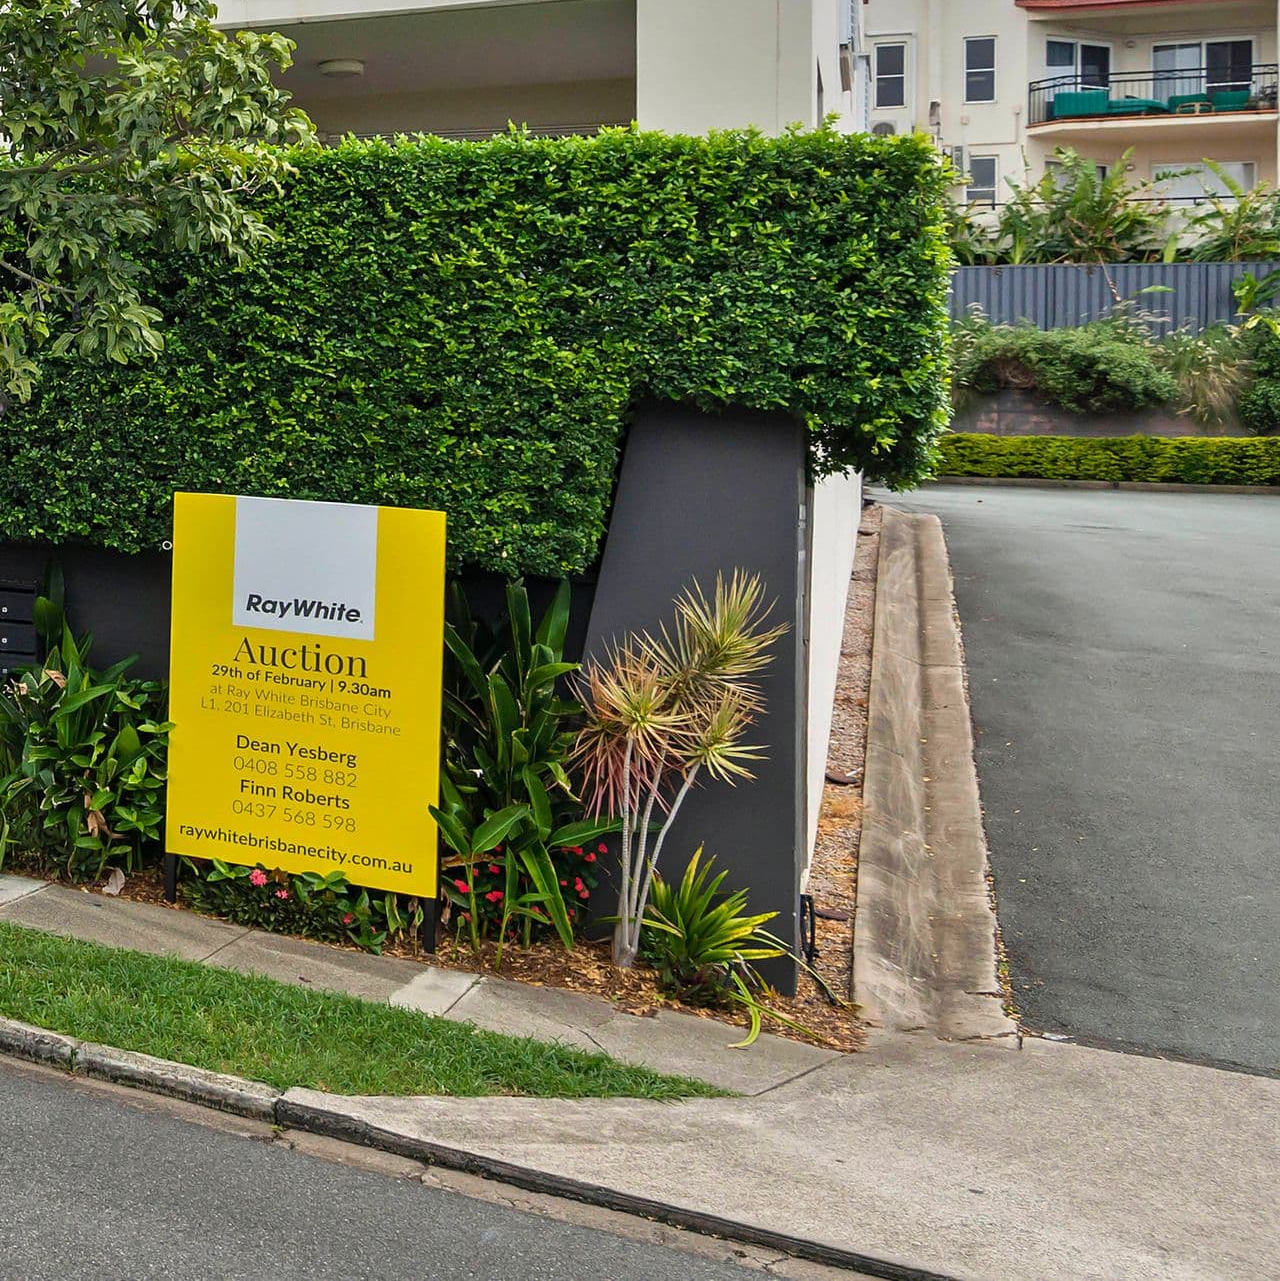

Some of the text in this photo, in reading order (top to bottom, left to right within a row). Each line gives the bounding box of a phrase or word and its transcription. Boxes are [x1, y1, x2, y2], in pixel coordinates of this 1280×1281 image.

[233, 637, 368, 678] Auction
[211, 664, 243, 680] 29th
[246, 670, 261, 681] of
[265, 671, 326, 692] February
[338, 680, 392, 699] 9.30am
[210, 685, 392, 719] at Ray White Brisbane City
[224, 700, 249, 715] 201
[254, 704, 315, 724] Elizabeth
[341, 719, 401, 737] Brisbane
[236, 734, 357, 769] Dean Yesberg
[233, 756, 357, 788] 0408 558 882
[240, 779, 350, 810] Finn Roberts
[232, 799, 356, 833] 0437 568 598
[179, 824, 413, 874] raywhitebrisbanecity.com.au
